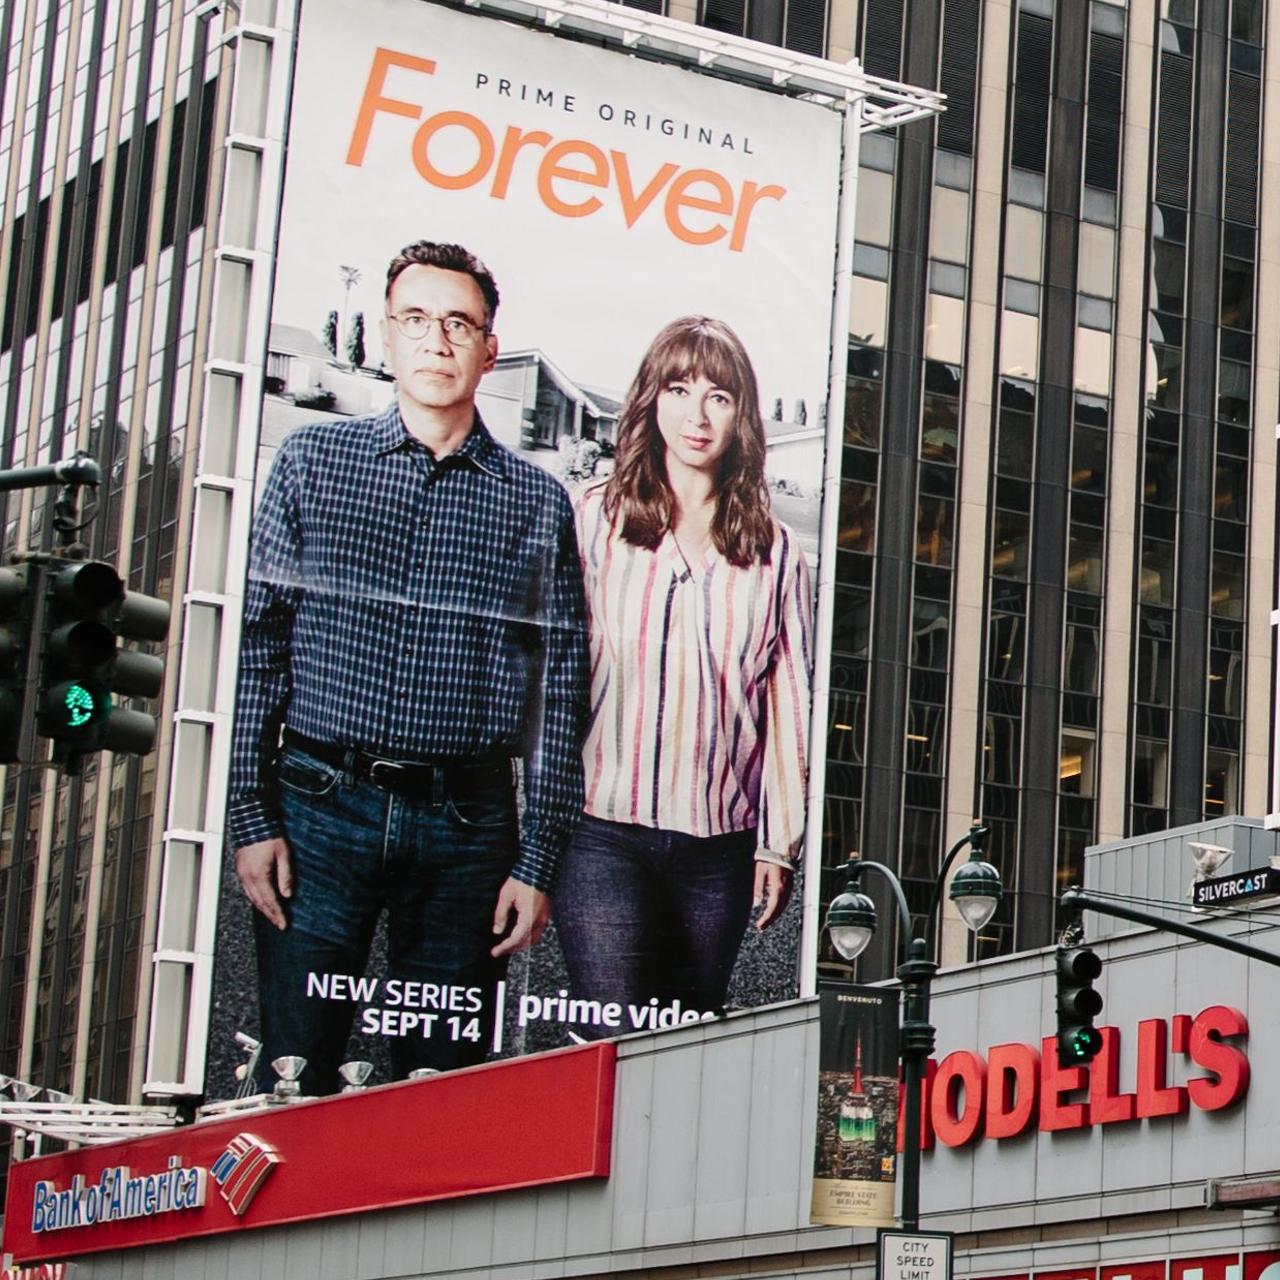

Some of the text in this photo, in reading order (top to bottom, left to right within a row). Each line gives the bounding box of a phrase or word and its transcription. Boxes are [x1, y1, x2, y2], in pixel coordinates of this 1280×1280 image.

[475, 72, 756, 155] PRIME ORIGINAL
[345, 46, 787, 252] Forever
[1198, 873, 1268, 903] SILVERCAST
[306, 972, 482, 1013] NEW SERIES
[518, 990, 622, 1028] prime
[837, 995, 883, 1005] BENVENUTO
[361, 1008, 481, 1042] SEPT 14
[32, 1154, 207, 1233] Bank of America
[896, 1255, 935, 1268] SPEED
[902, 1242, 929, 1255] CITY
